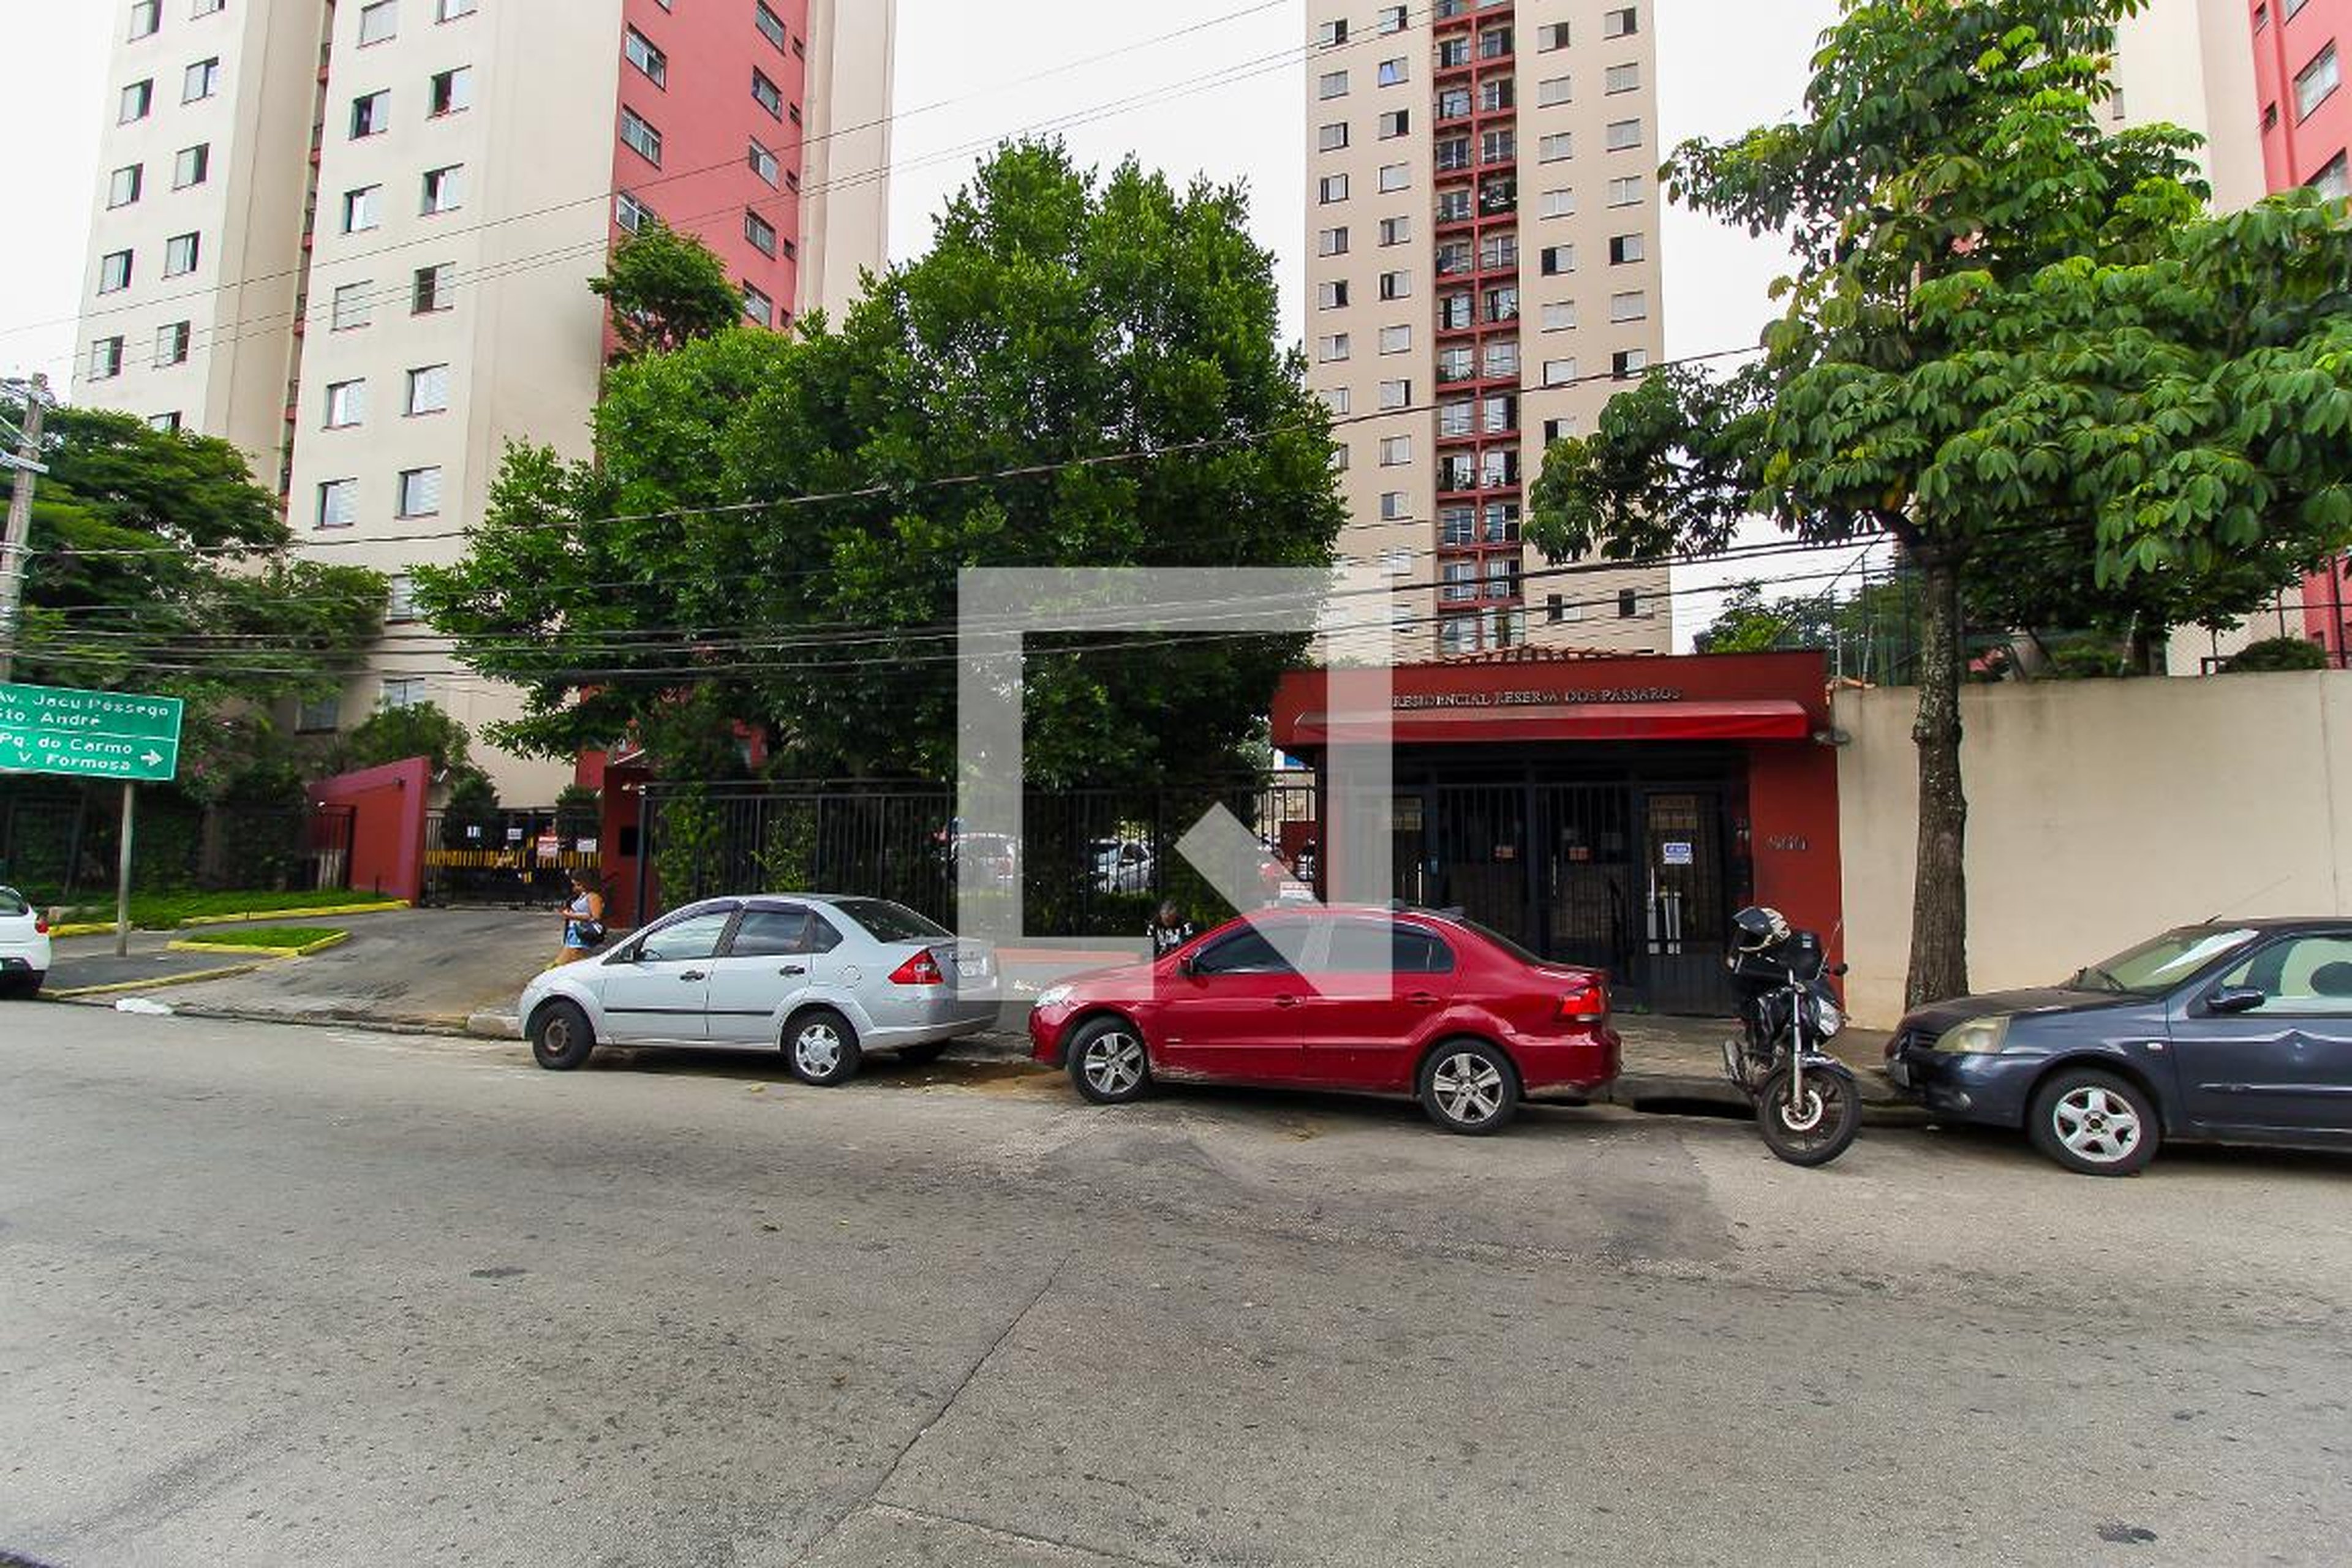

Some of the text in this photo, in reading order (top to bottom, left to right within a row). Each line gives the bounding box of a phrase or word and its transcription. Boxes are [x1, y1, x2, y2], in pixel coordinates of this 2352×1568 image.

[32, 694, 81, 709] Jacu
[1393, 693, 1491, 707] RESIDENCIAL
[1494, 690, 1559, 704] RESERVA
[40, 712, 100, 725] André
[0, 733, 132, 754] Pq. do Carmo
[18, 752, 130, 771] V. Formosa
